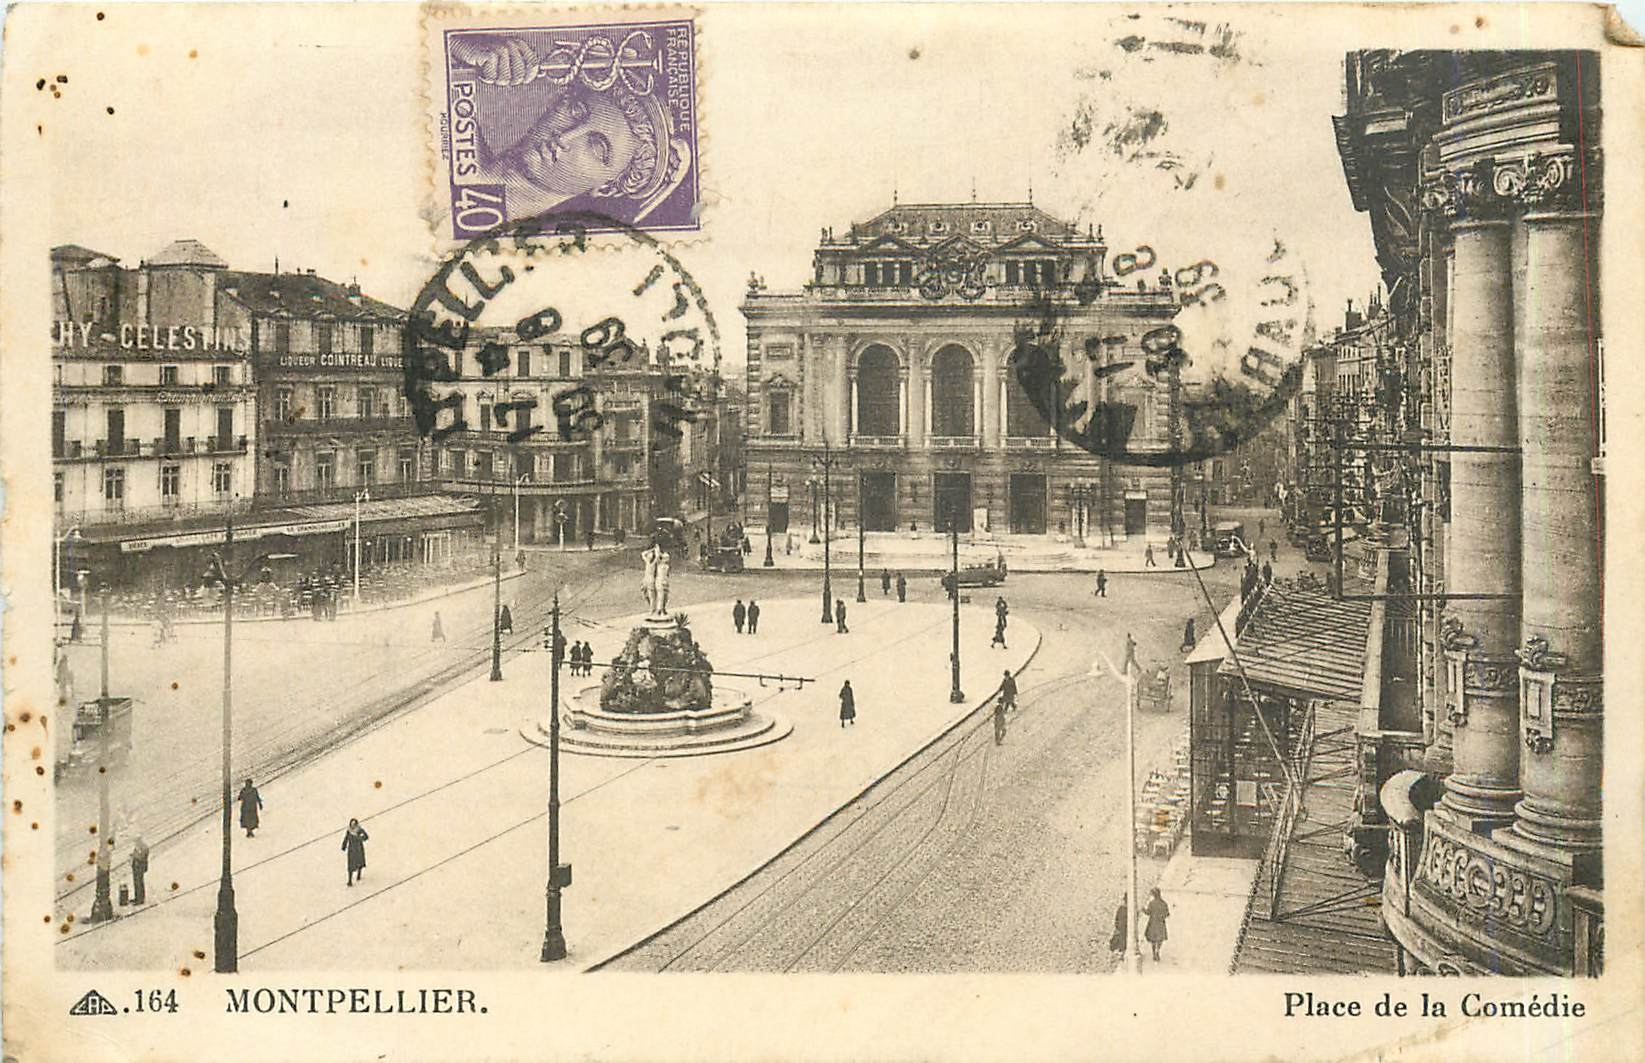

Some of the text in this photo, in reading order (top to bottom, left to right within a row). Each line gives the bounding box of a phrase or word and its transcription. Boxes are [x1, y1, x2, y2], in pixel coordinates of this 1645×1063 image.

[453, 82, 477, 178] POSTES
[455, 186, 504, 232] 40
[121, 324, 250, 352] CELESTINS
[280, 356, 316, 367] LIQUEUR
[320, 354, 377, 367] COINTREAU
